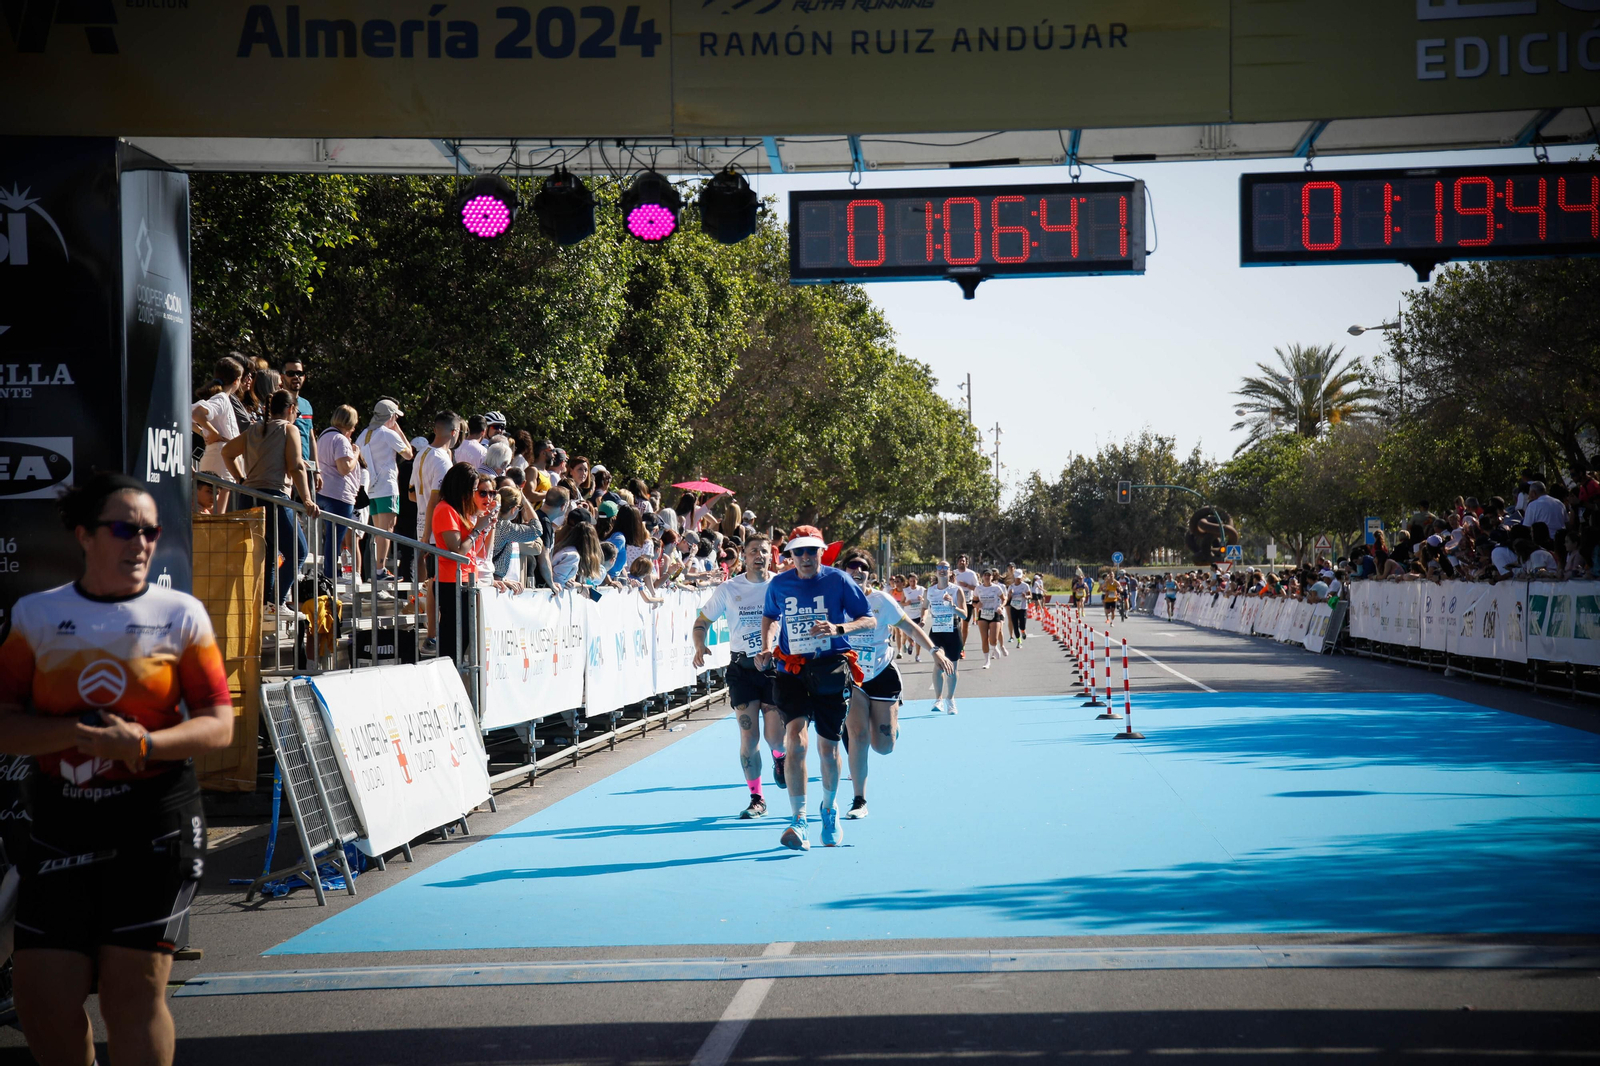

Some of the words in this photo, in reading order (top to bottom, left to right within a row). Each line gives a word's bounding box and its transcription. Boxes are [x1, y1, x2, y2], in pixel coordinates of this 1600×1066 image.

[236, 4, 480, 59] Almería
[494, 5, 662, 59] 2024
[700, 25, 832, 57] RAMÓN
[851, 28, 935, 55] RUIZ
[951, 19, 1128, 52] ANDÚJAR
[1302, 175, 1600, 251] 01:19:44
[0, 363, 75, 386] LLA
[785, 596, 798, 616] 3
[798, 606, 813, 614] en
[812, 595, 828, 614] 1
